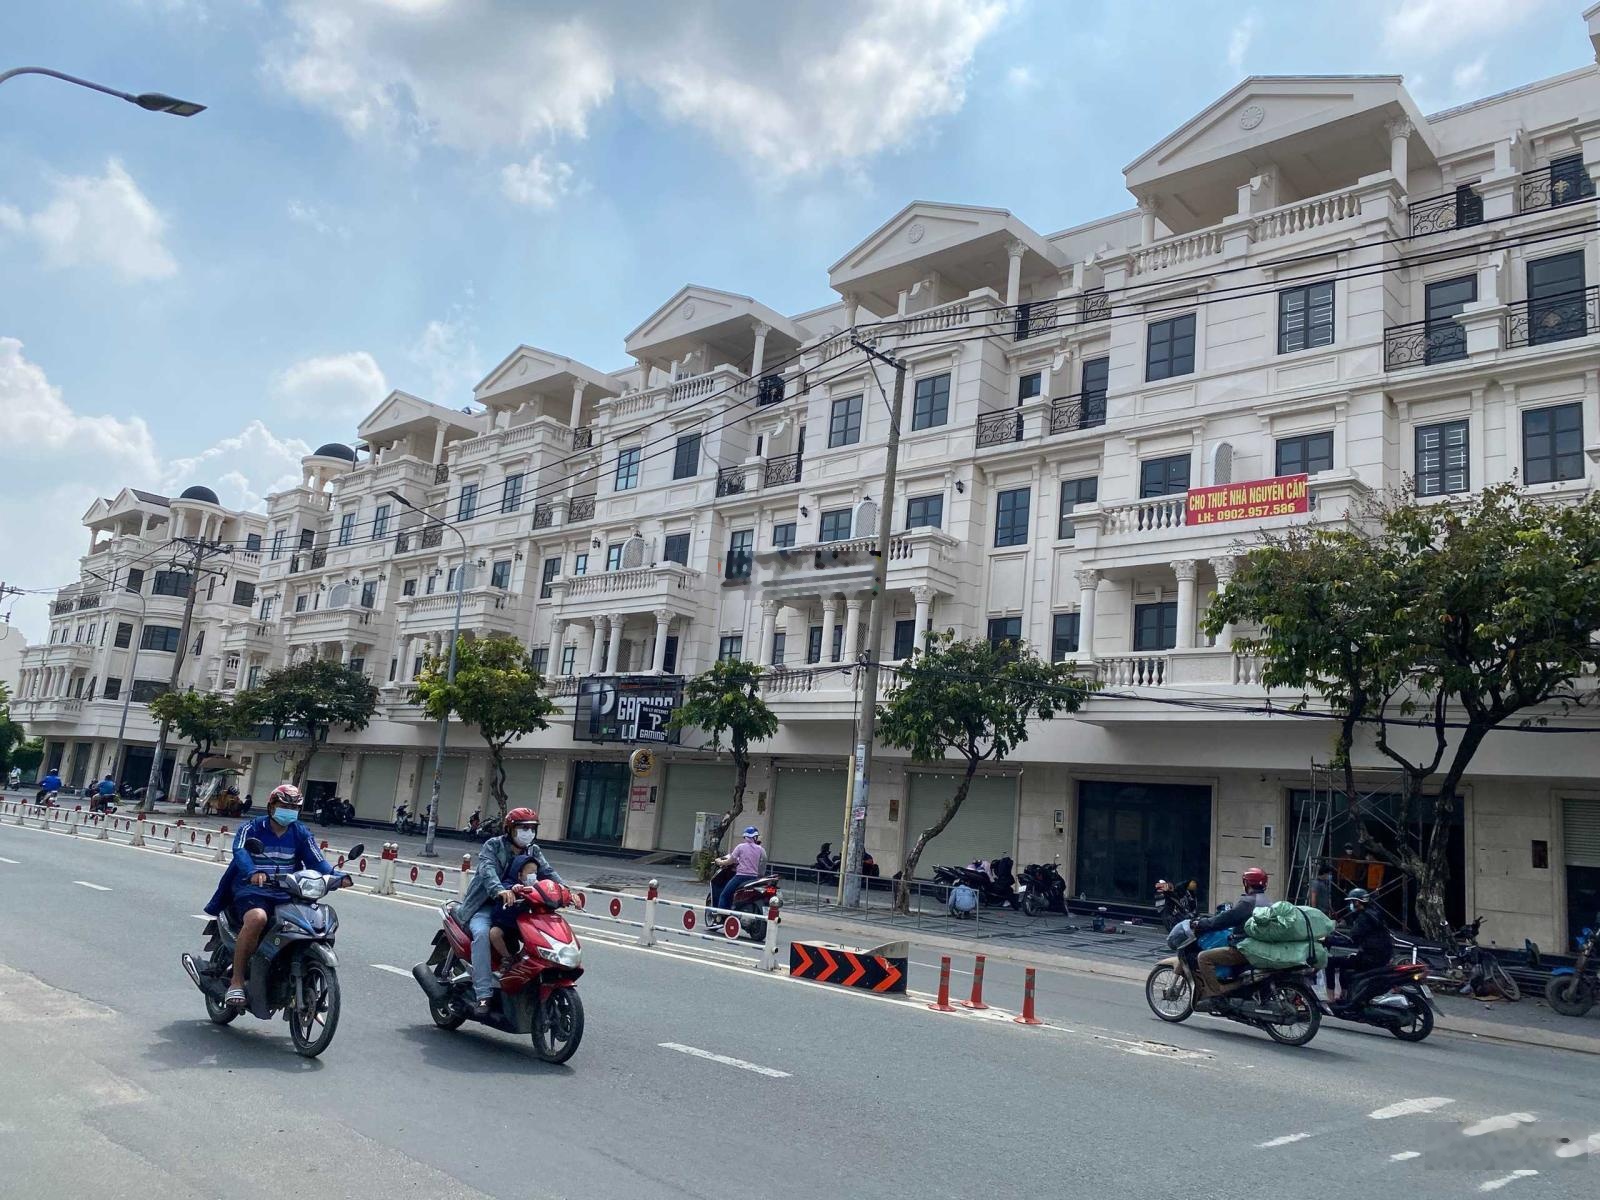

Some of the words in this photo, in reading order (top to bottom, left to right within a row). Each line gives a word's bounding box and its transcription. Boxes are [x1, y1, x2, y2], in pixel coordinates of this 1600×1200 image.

[1189, 494, 1206, 511] CHO
[1207, 488, 1228, 509] THUÊ
[1229, 485, 1247, 506] NHÀ
[1249, 481, 1284, 503] NGUYÊN
[1286, 479, 1306, 499] CĂN
[1198, 512, 1214, 523] LH:
[1217, 502, 1296, 521] 0902.957.586
